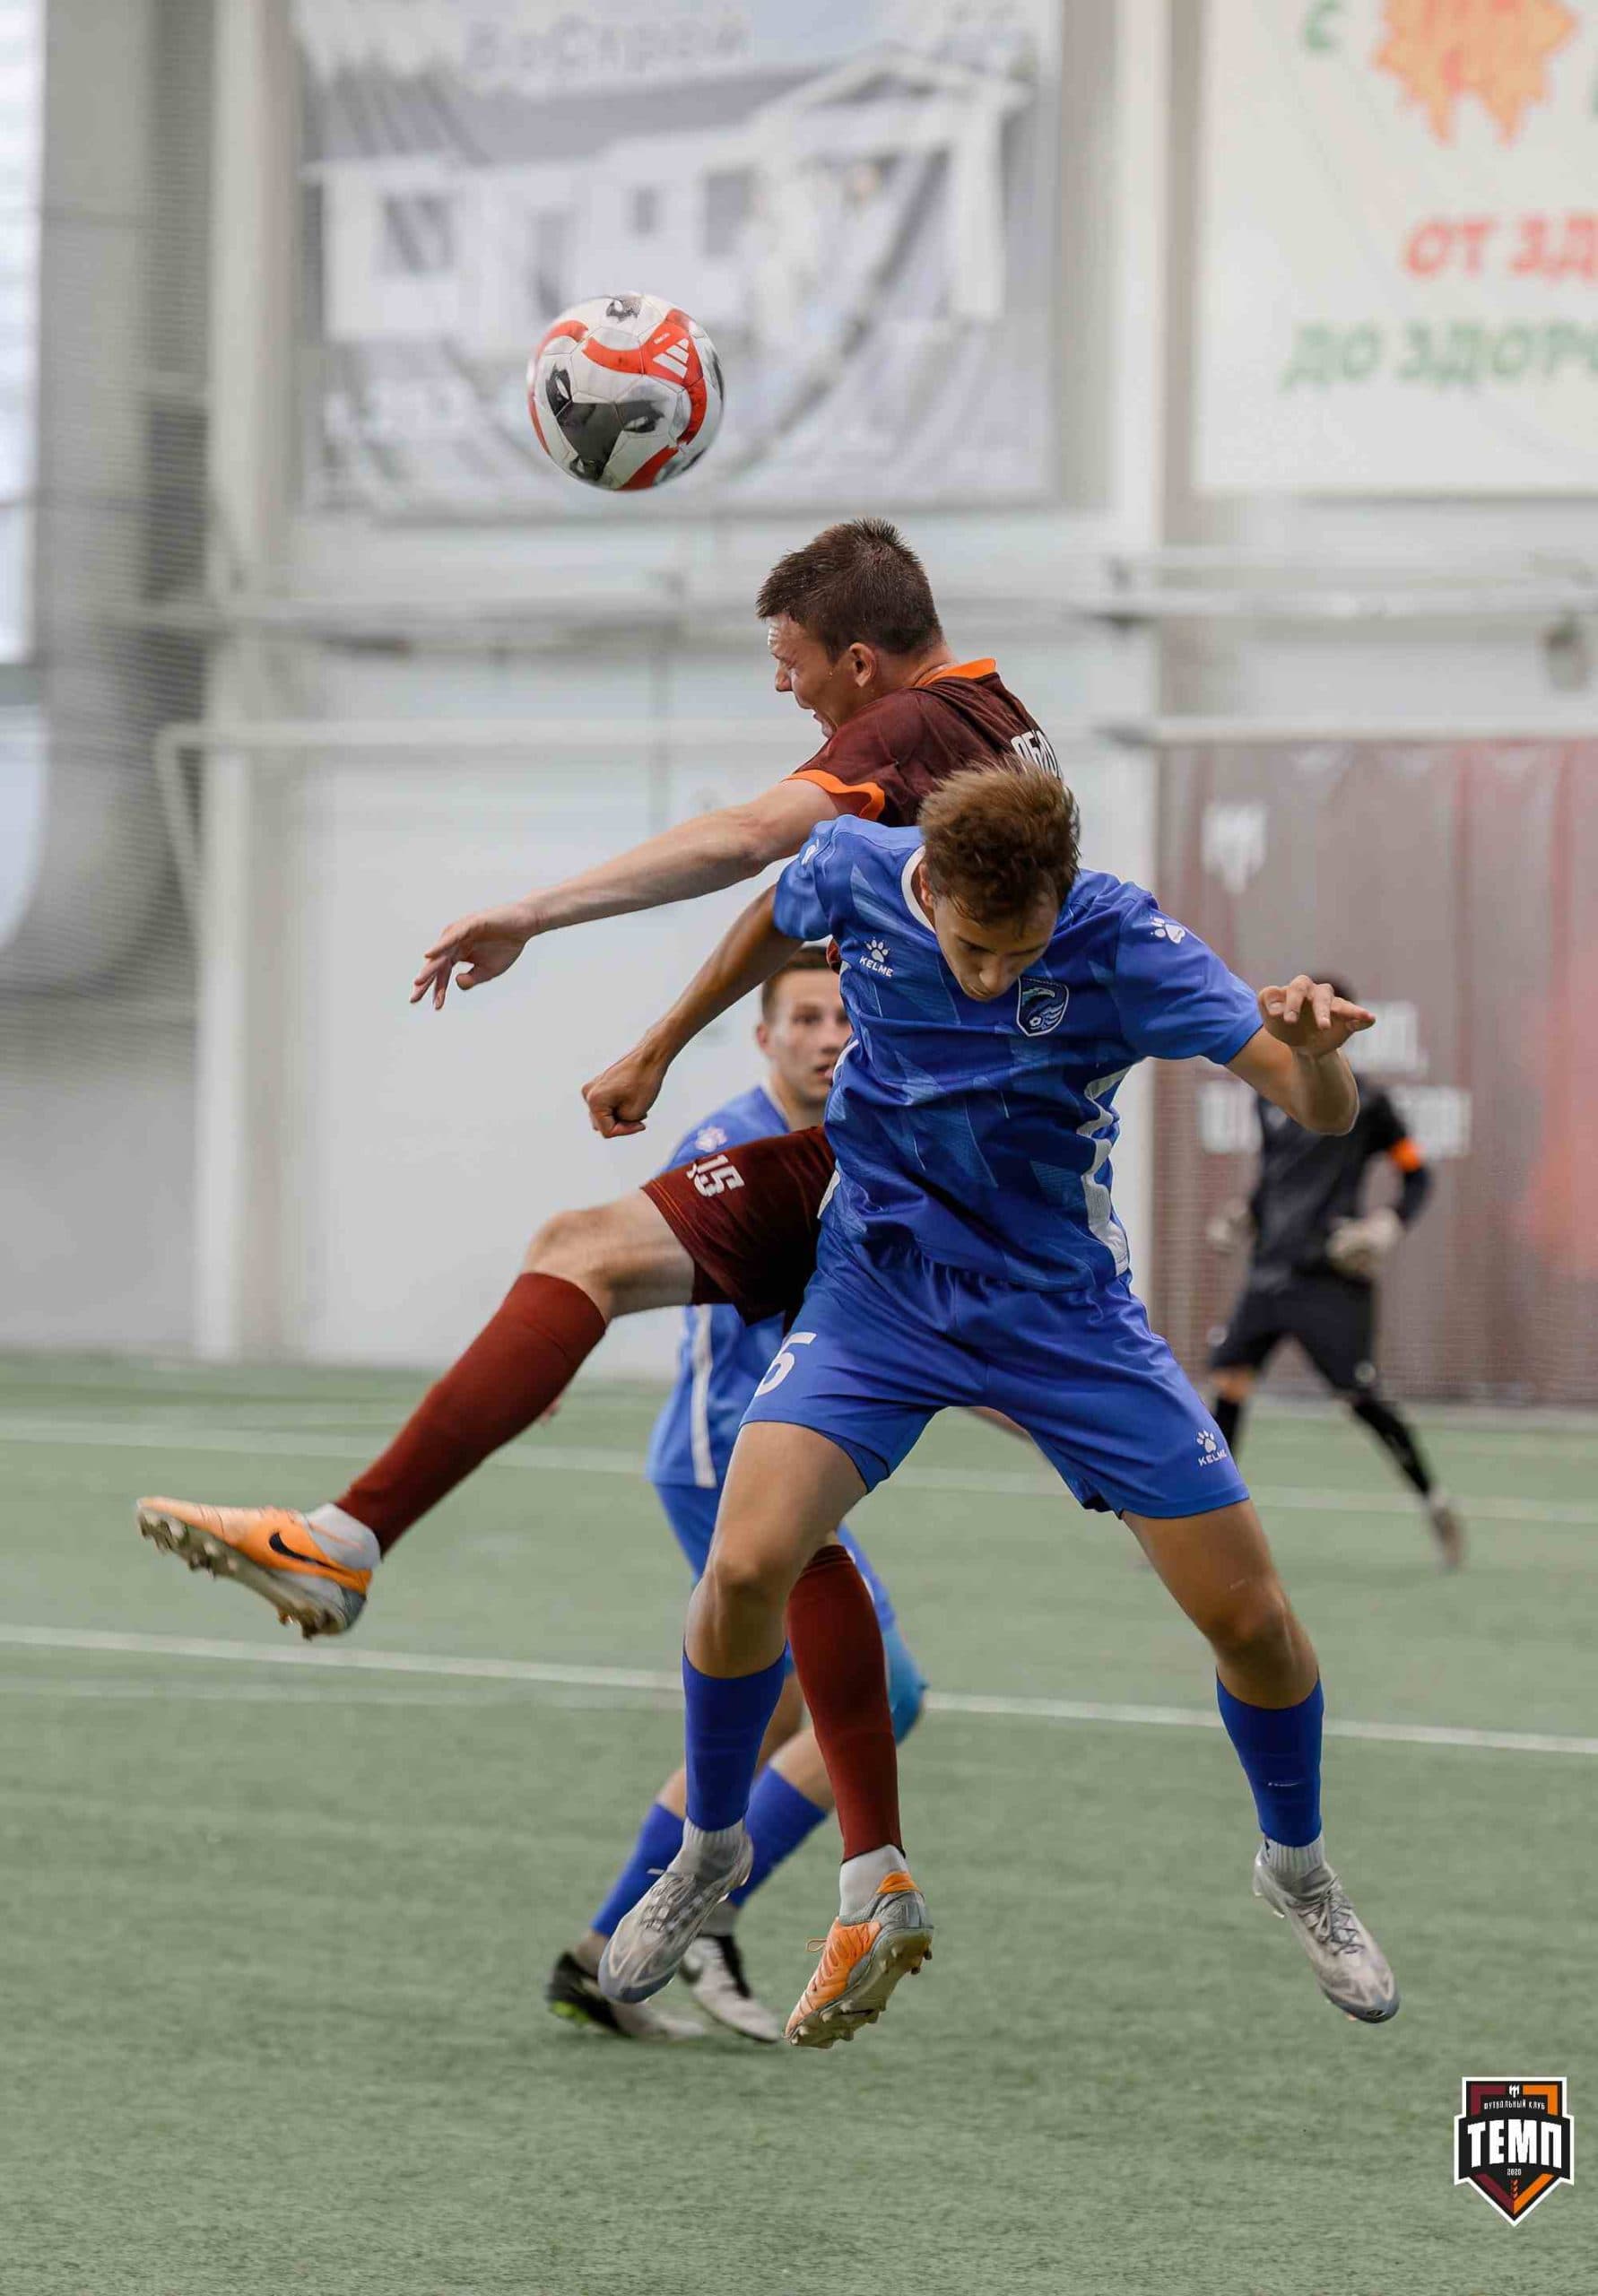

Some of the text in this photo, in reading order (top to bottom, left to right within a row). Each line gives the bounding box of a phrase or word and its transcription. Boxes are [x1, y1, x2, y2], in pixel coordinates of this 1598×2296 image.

[1404, 218, 1497, 278] ОТ
[1281, 321, 1380, 393] ДО
[859, 955, 894, 978] KELME
[686, 1154, 745, 1197] 15
